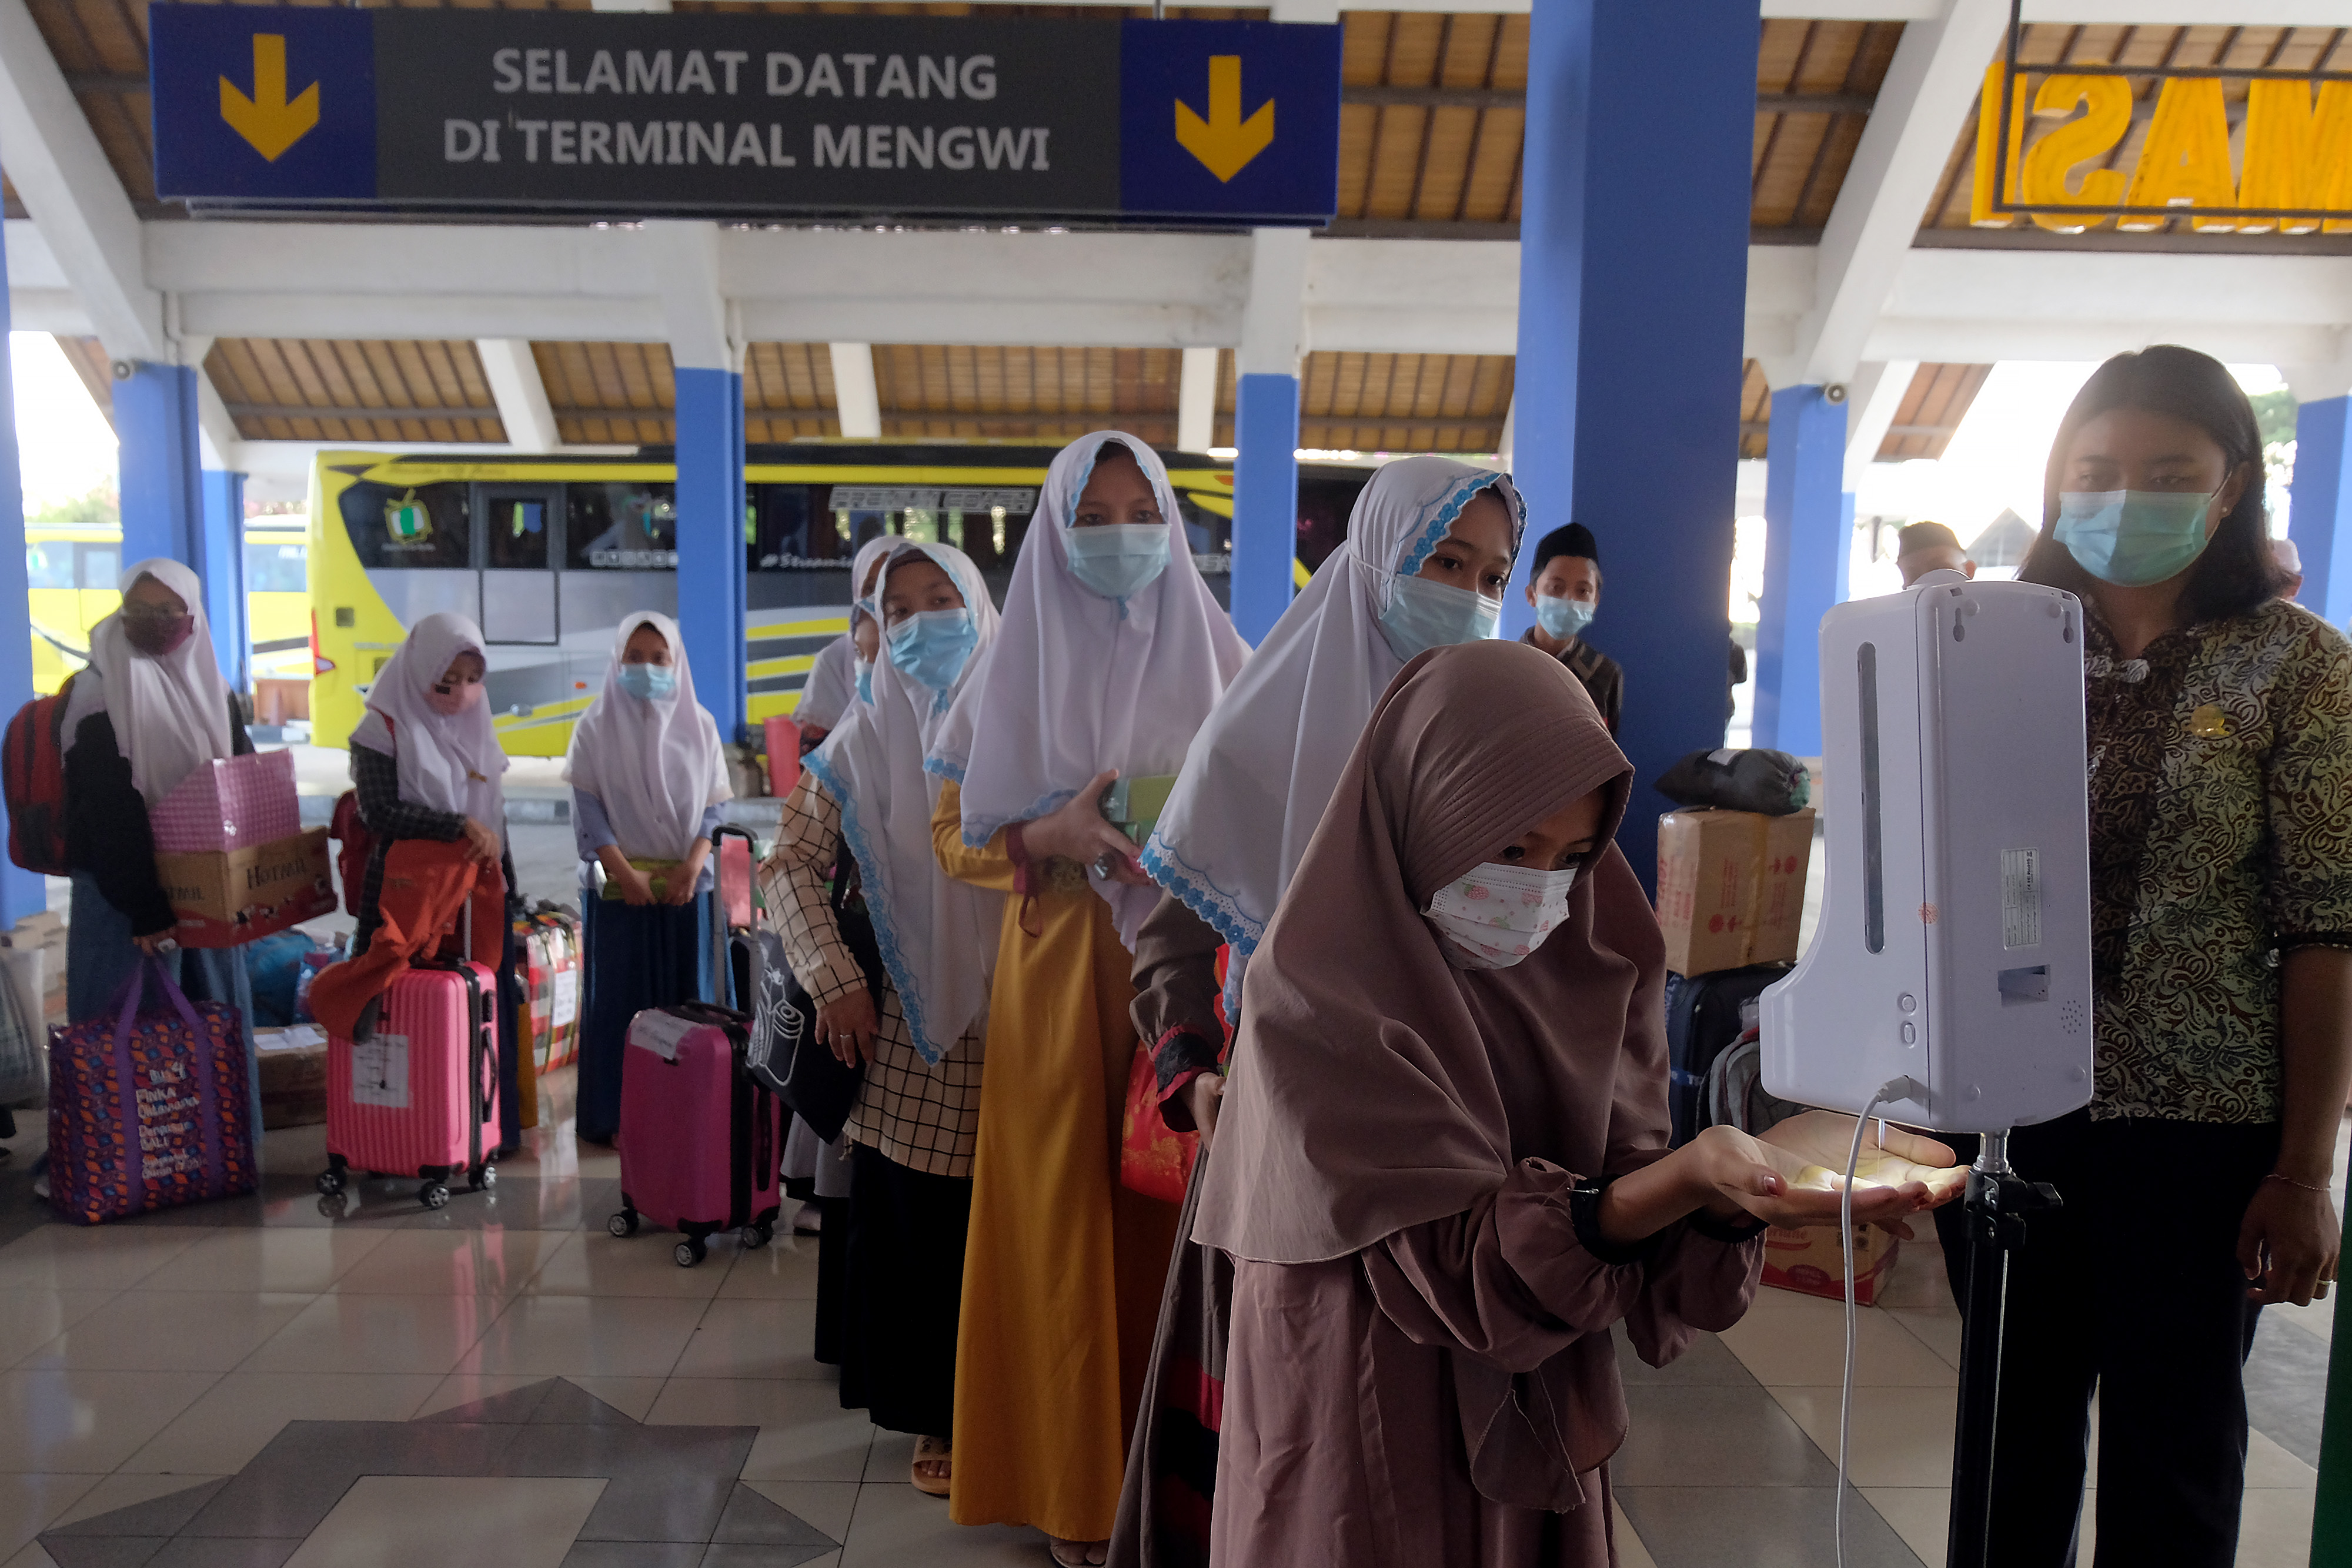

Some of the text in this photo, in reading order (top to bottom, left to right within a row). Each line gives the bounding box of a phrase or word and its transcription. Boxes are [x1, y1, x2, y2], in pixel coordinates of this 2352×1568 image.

[493, 48, 997, 100] SELAMAT DATANG
[444, 119, 1050, 171] DI TERMINAL MENGWI
